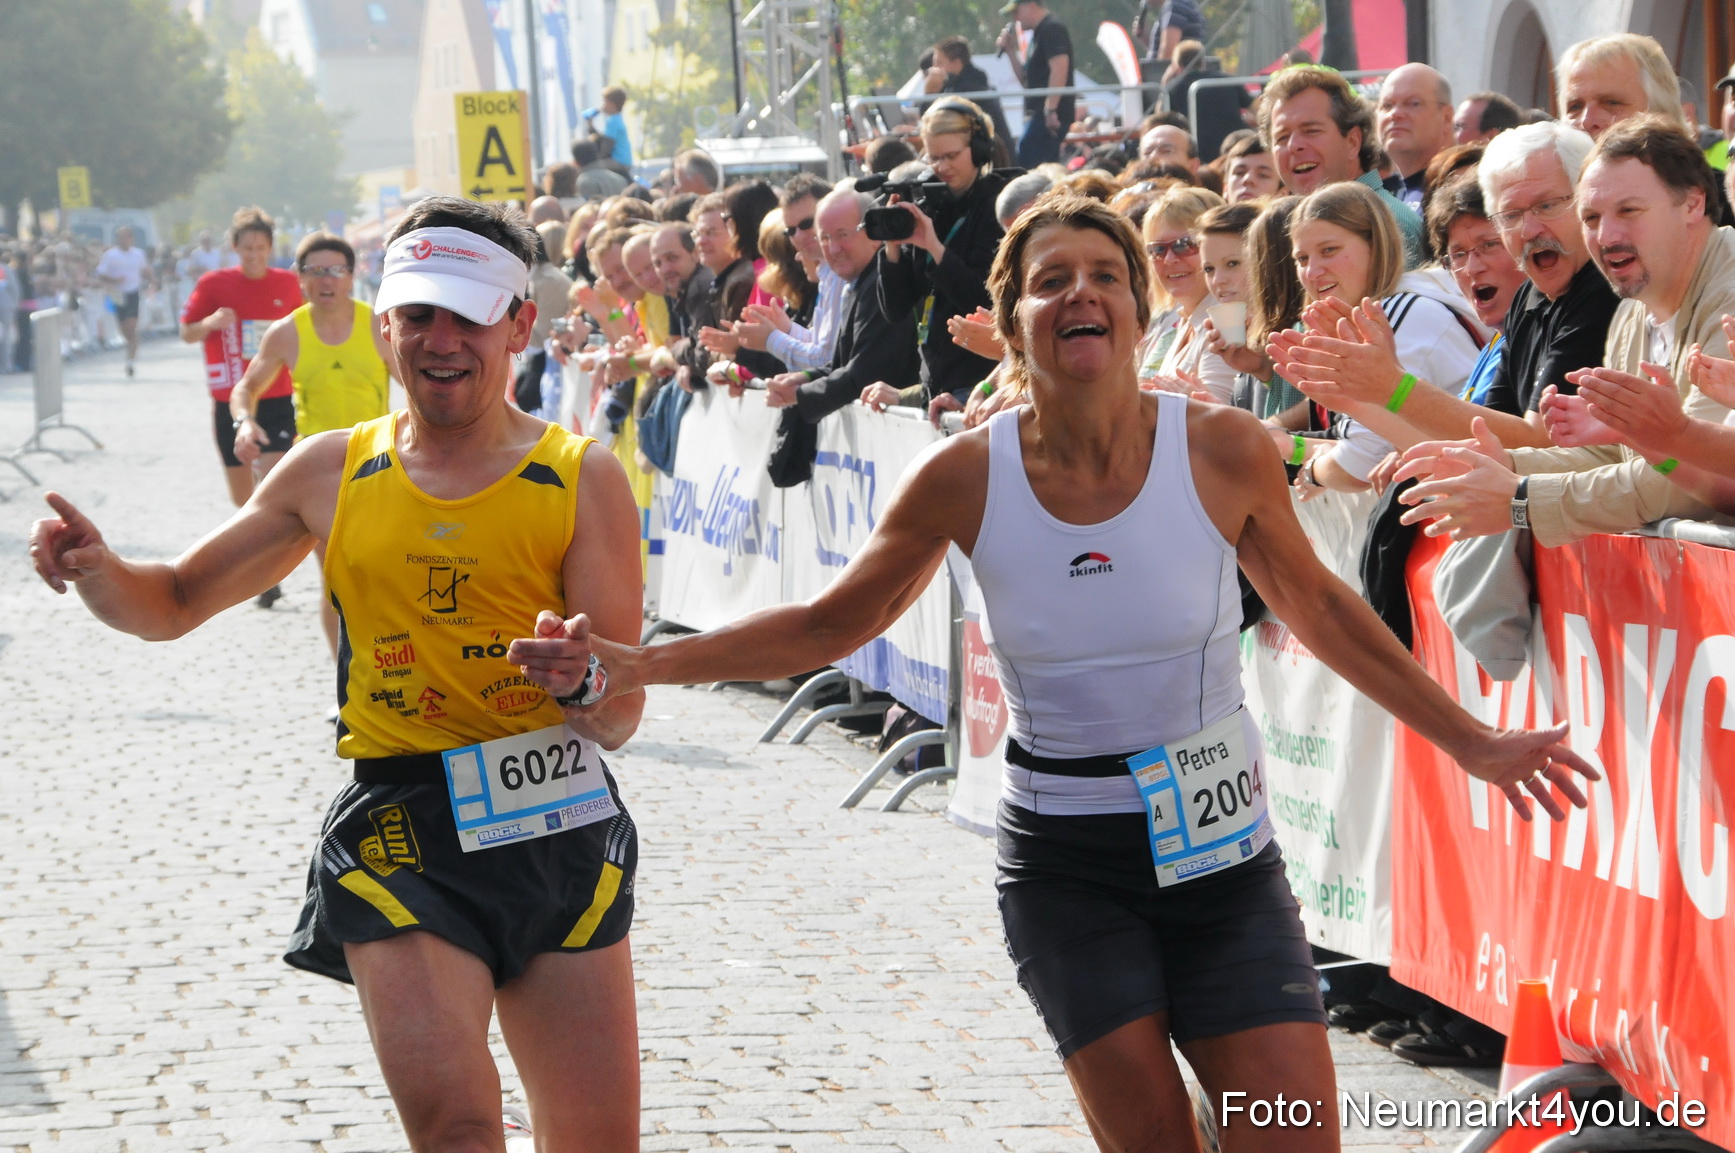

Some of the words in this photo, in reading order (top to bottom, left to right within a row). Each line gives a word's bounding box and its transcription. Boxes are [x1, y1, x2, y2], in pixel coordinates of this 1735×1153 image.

[462, 95, 520, 116] Block
[475, 125, 516, 177] A
[1069, 563, 1113, 578] skinfit
[373, 630, 410, 645] Schreinerei
[374, 644, 416, 669] Seidl
[382, 668, 412, 679] Berngau
[499, 739, 587, 791] 6022
[1176, 741, 1229, 776] Petra
[1193, 760, 1263, 829] 2004
[561, 797, 612, 820] PFLEIDERER
[1154, 804, 1163, 822] A
[378, 807, 416, 864] Run!
[477, 823, 521, 841] BOCK
[1175, 853, 1218, 875] BOCK
